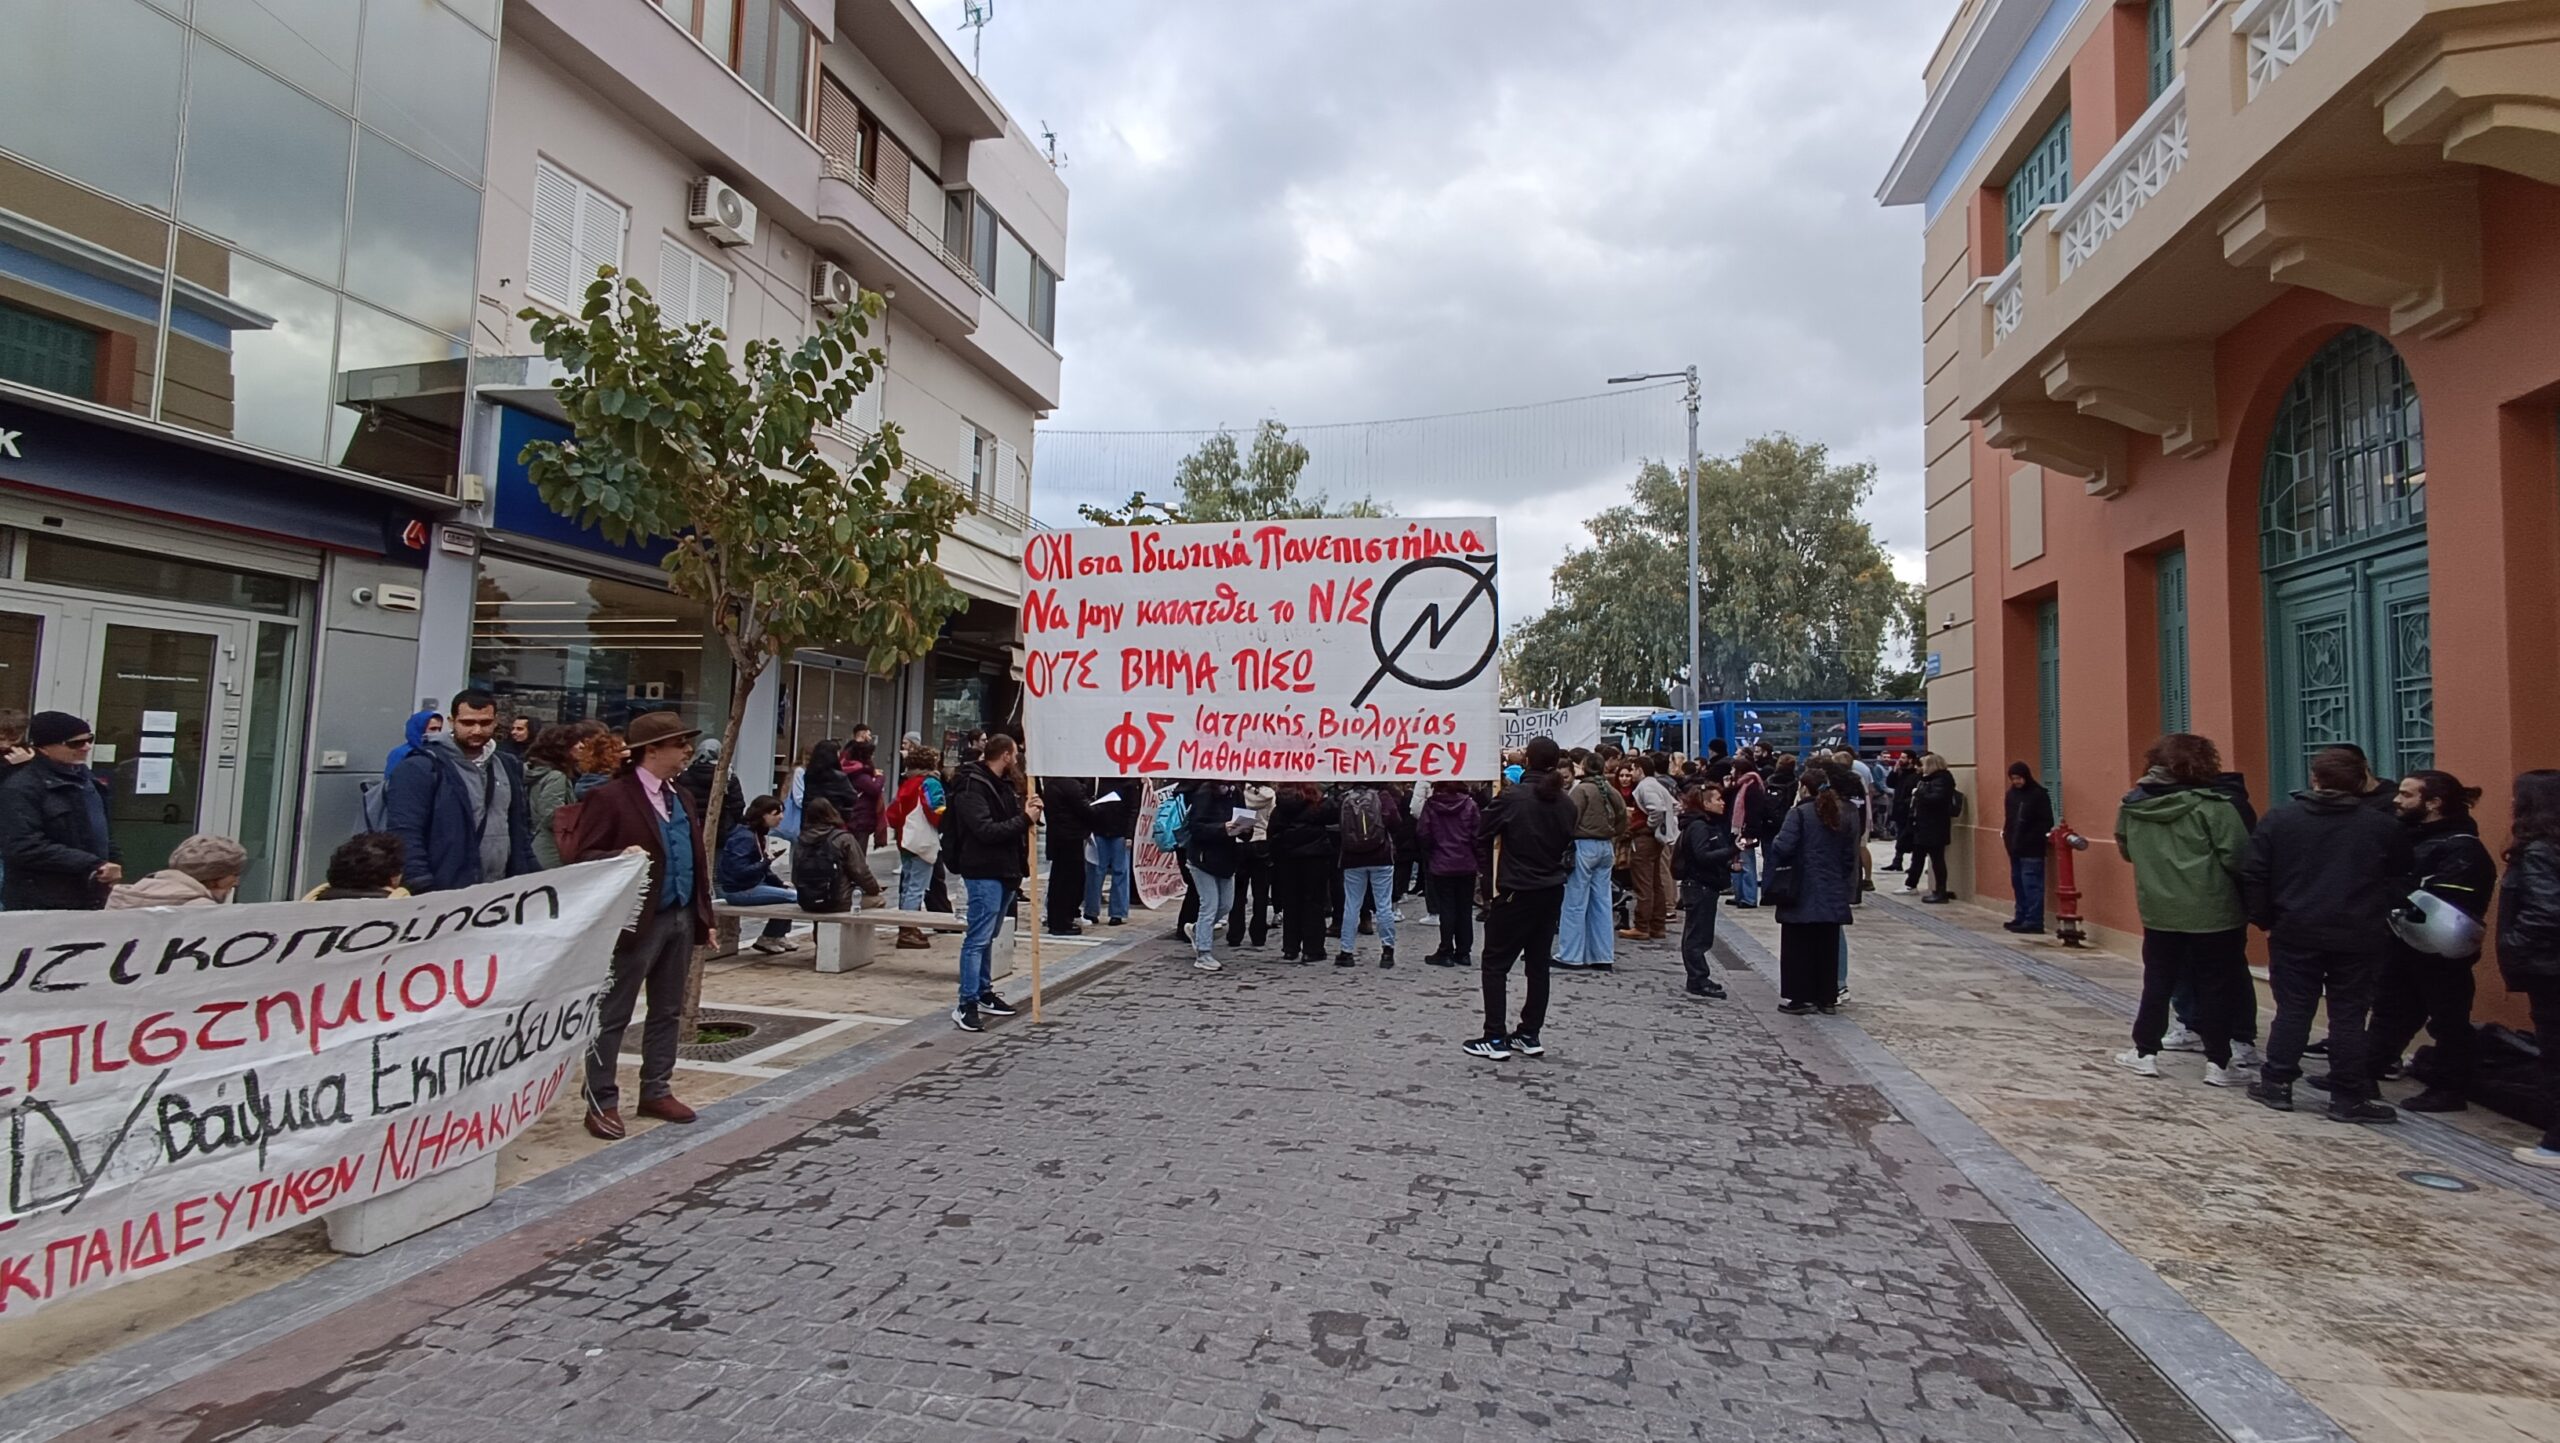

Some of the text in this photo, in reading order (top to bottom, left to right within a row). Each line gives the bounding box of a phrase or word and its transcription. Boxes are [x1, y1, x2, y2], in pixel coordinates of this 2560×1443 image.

[1024, 524, 1485, 582] ΟΧΙ στα Ιδιωτικά Πανεπιστήμια
[1022, 588, 1069, 634] Να
[1077, 598, 1124, 639] μην
[1268, 599, 1296, 624] το
[1308, 577, 1373, 625] Ν/Σ
[1025, 647, 1316, 698] ΟΥΤΕ ΒΗΜΑ ΠΙΣΩ
[1105, 711, 1175, 775] ΦΣ
[1195, 703, 1456, 747] Ιατρικής, Βιολογίας
[1499, 728, 1554, 747] ΙΣΤΗΜΙΑ
[1506, 710, 1568, 734] ΙΔΙΩΤΙΚΑ
[1389, 741, 1467, 776] ΣΕΥ
[0, 1156, 365, 1312] ΚΠΑΙΔΕΥΤΙΚΩΝ
